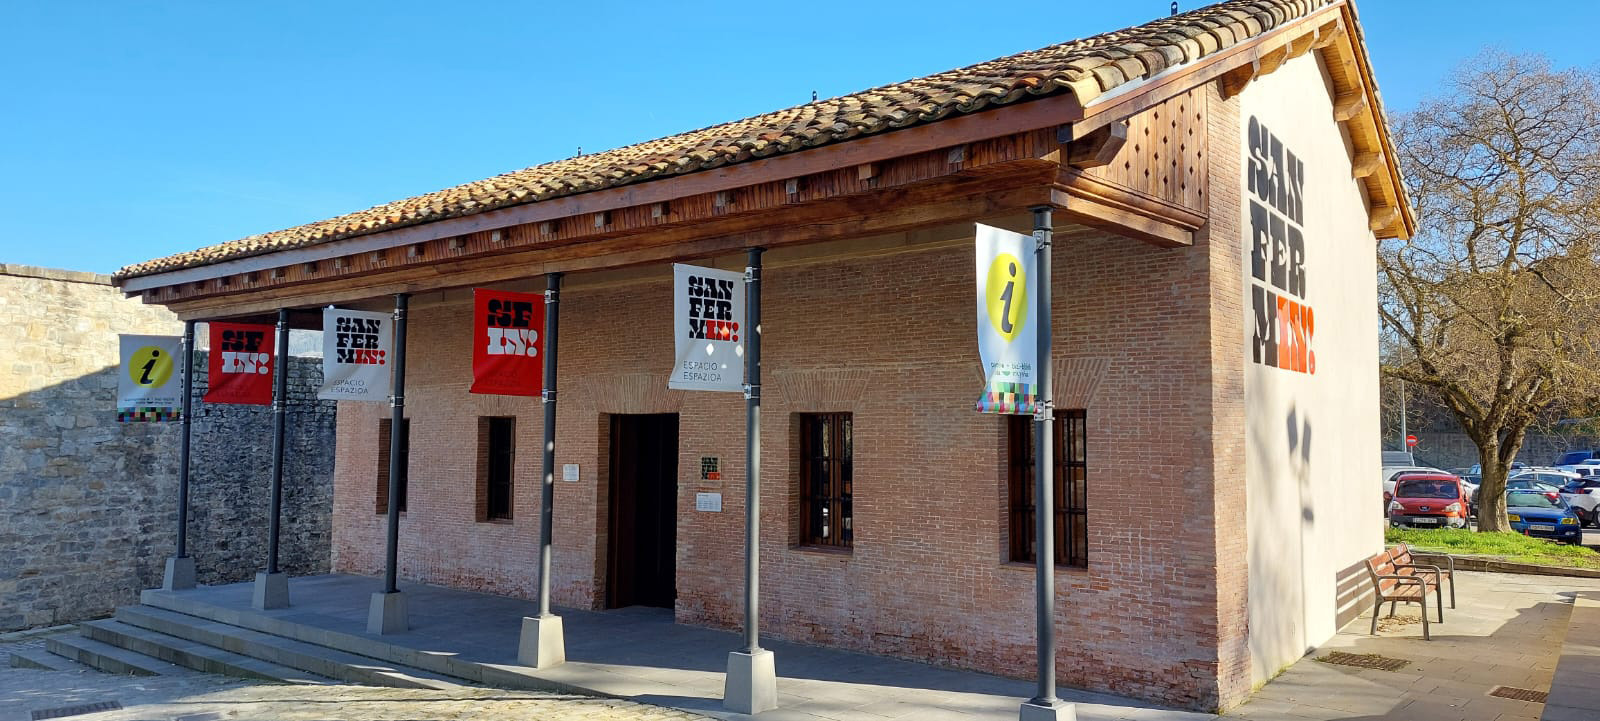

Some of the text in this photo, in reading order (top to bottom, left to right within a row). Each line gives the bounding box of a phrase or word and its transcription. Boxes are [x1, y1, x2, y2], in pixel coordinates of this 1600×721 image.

[1247, 114, 1304, 227] SAN
[1249, 197, 1306, 300] FER
[688, 275, 734, 300] SAN
[487, 298, 533, 327] SF
[688, 297, 733, 321] FER
[336, 316, 381, 334] SAN
[688, 318, 739, 342] MIN!
[1252, 283, 1315, 375] MIN!
[221, 329, 265, 351] SF
[336, 333, 380, 349] FER
[487, 327, 538, 357] IN!
[221, 351, 270, 375] IN!
[336, 348, 386, 365] MIN!
[683, 360, 718, 370] ESPACIO
[683, 371, 722, 382] ESPAZIOA
